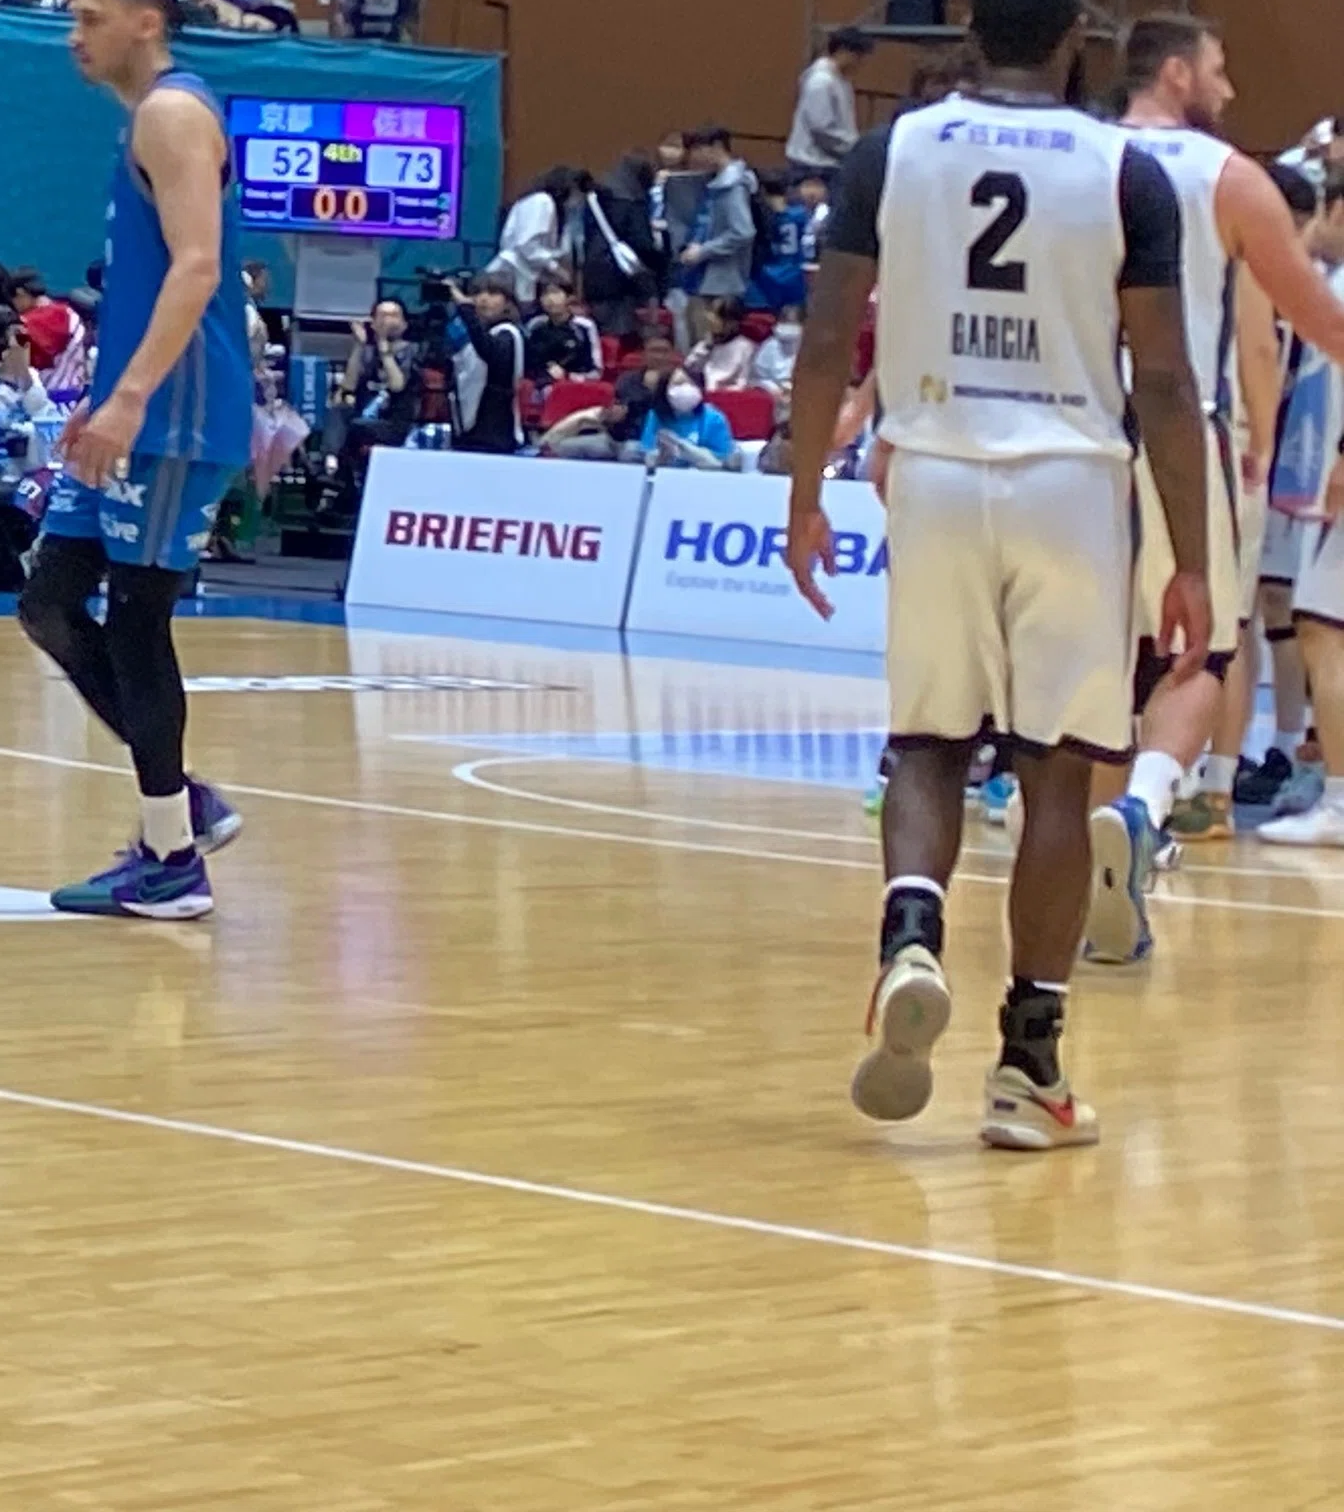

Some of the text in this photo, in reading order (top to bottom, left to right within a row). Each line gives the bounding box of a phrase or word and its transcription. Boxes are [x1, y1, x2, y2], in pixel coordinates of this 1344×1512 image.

[273, 147, 312, 177] 52
[396, 152, 434, 183] 73
[314, 188, 368, 220] 0.0
[967, 170, 1028, 292] 2
[951, 313, 1040, 362] GARCIA
[384, 510, 602, 563] BRIEFING
[665, 519, 889, 576] HORBA
